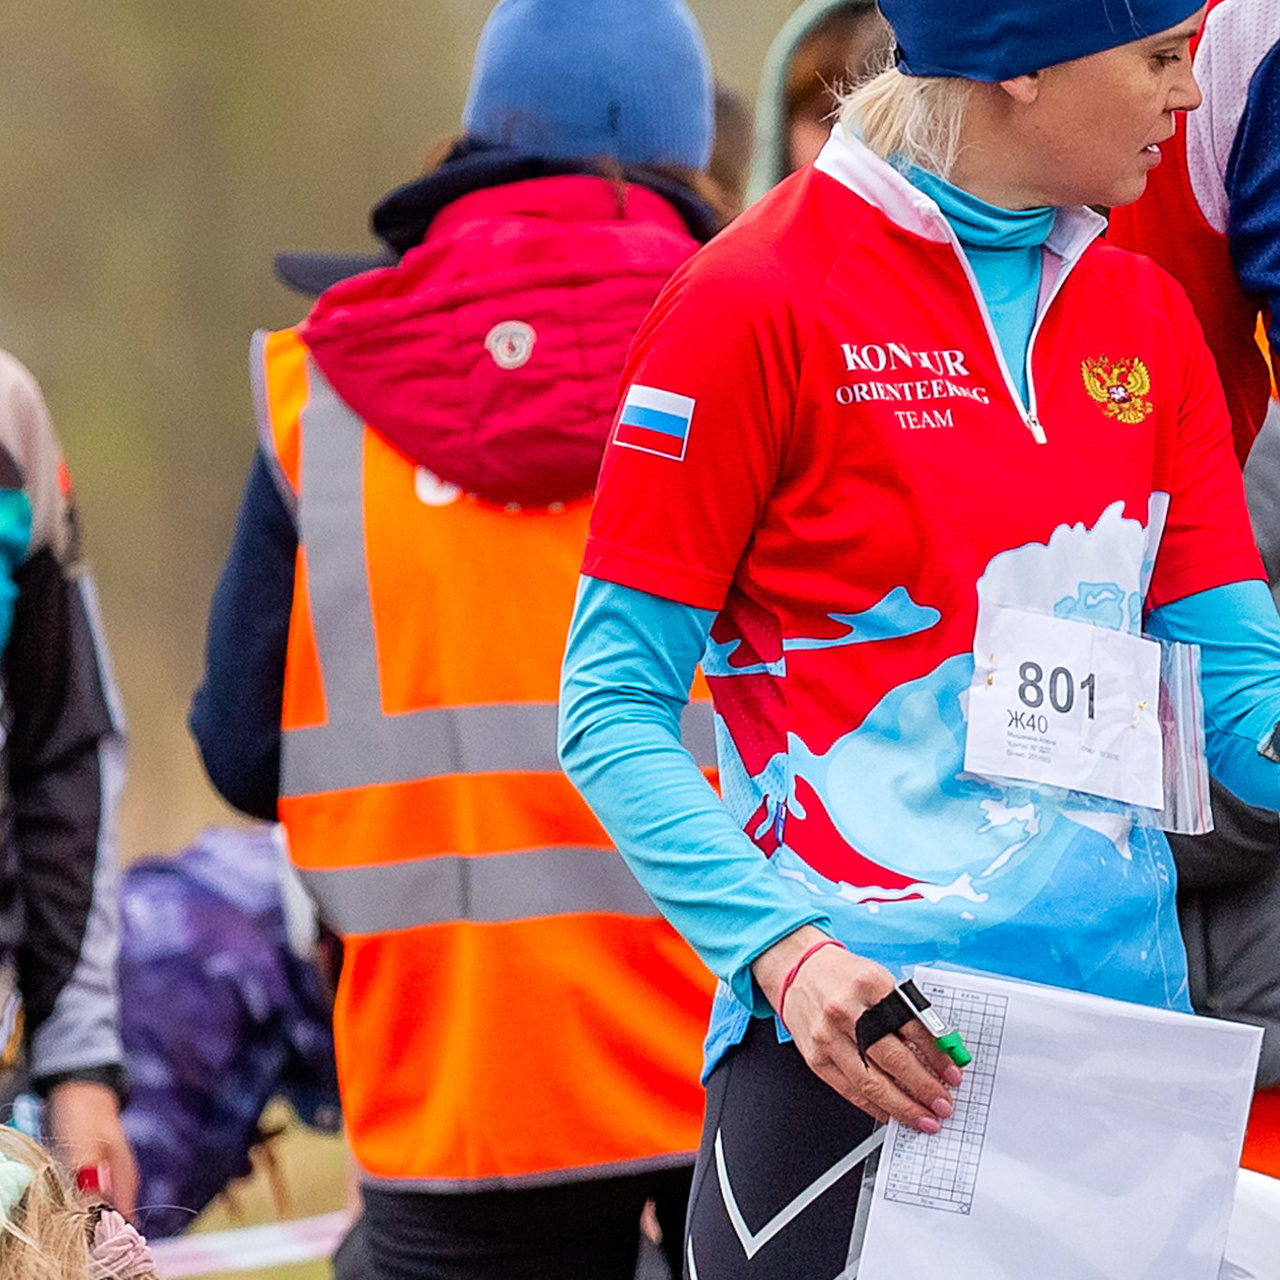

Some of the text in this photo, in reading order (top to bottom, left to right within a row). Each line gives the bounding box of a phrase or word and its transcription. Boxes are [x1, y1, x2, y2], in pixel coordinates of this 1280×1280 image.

[894, 408, 954, 430] TEAM
[1018, 661, 1095, 720] 801
[1006, 708, 1049, 734] Ж40
